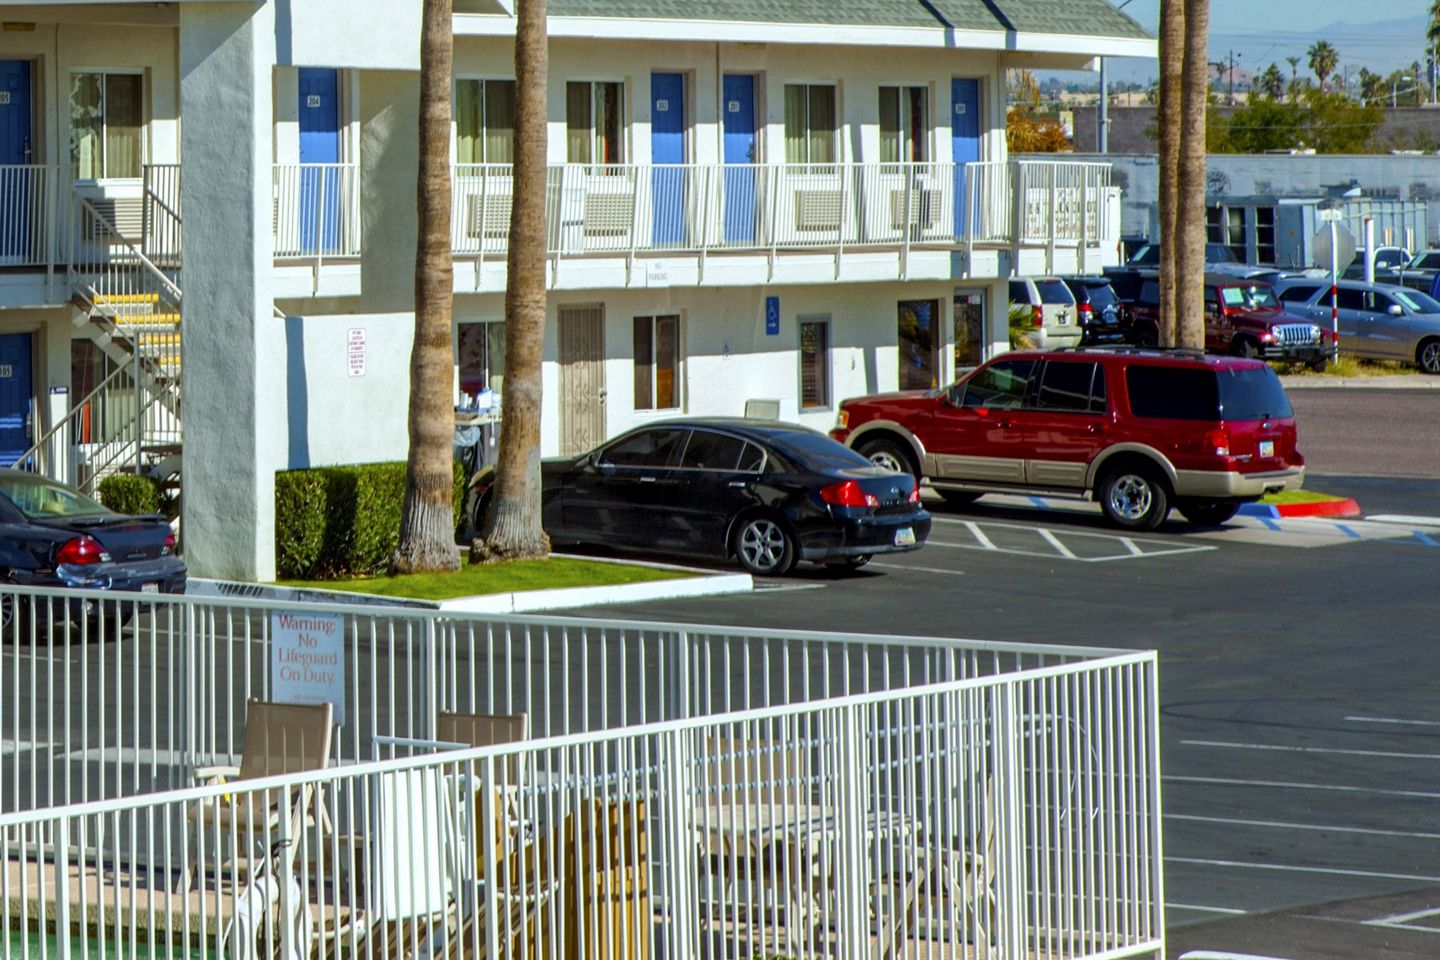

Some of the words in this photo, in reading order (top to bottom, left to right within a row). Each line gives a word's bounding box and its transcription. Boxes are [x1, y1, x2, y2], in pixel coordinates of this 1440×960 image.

[298, 633, 317, 648] No
[278, 647, 337, 667] Lifeguard
[280, 665, 301, 681] On
